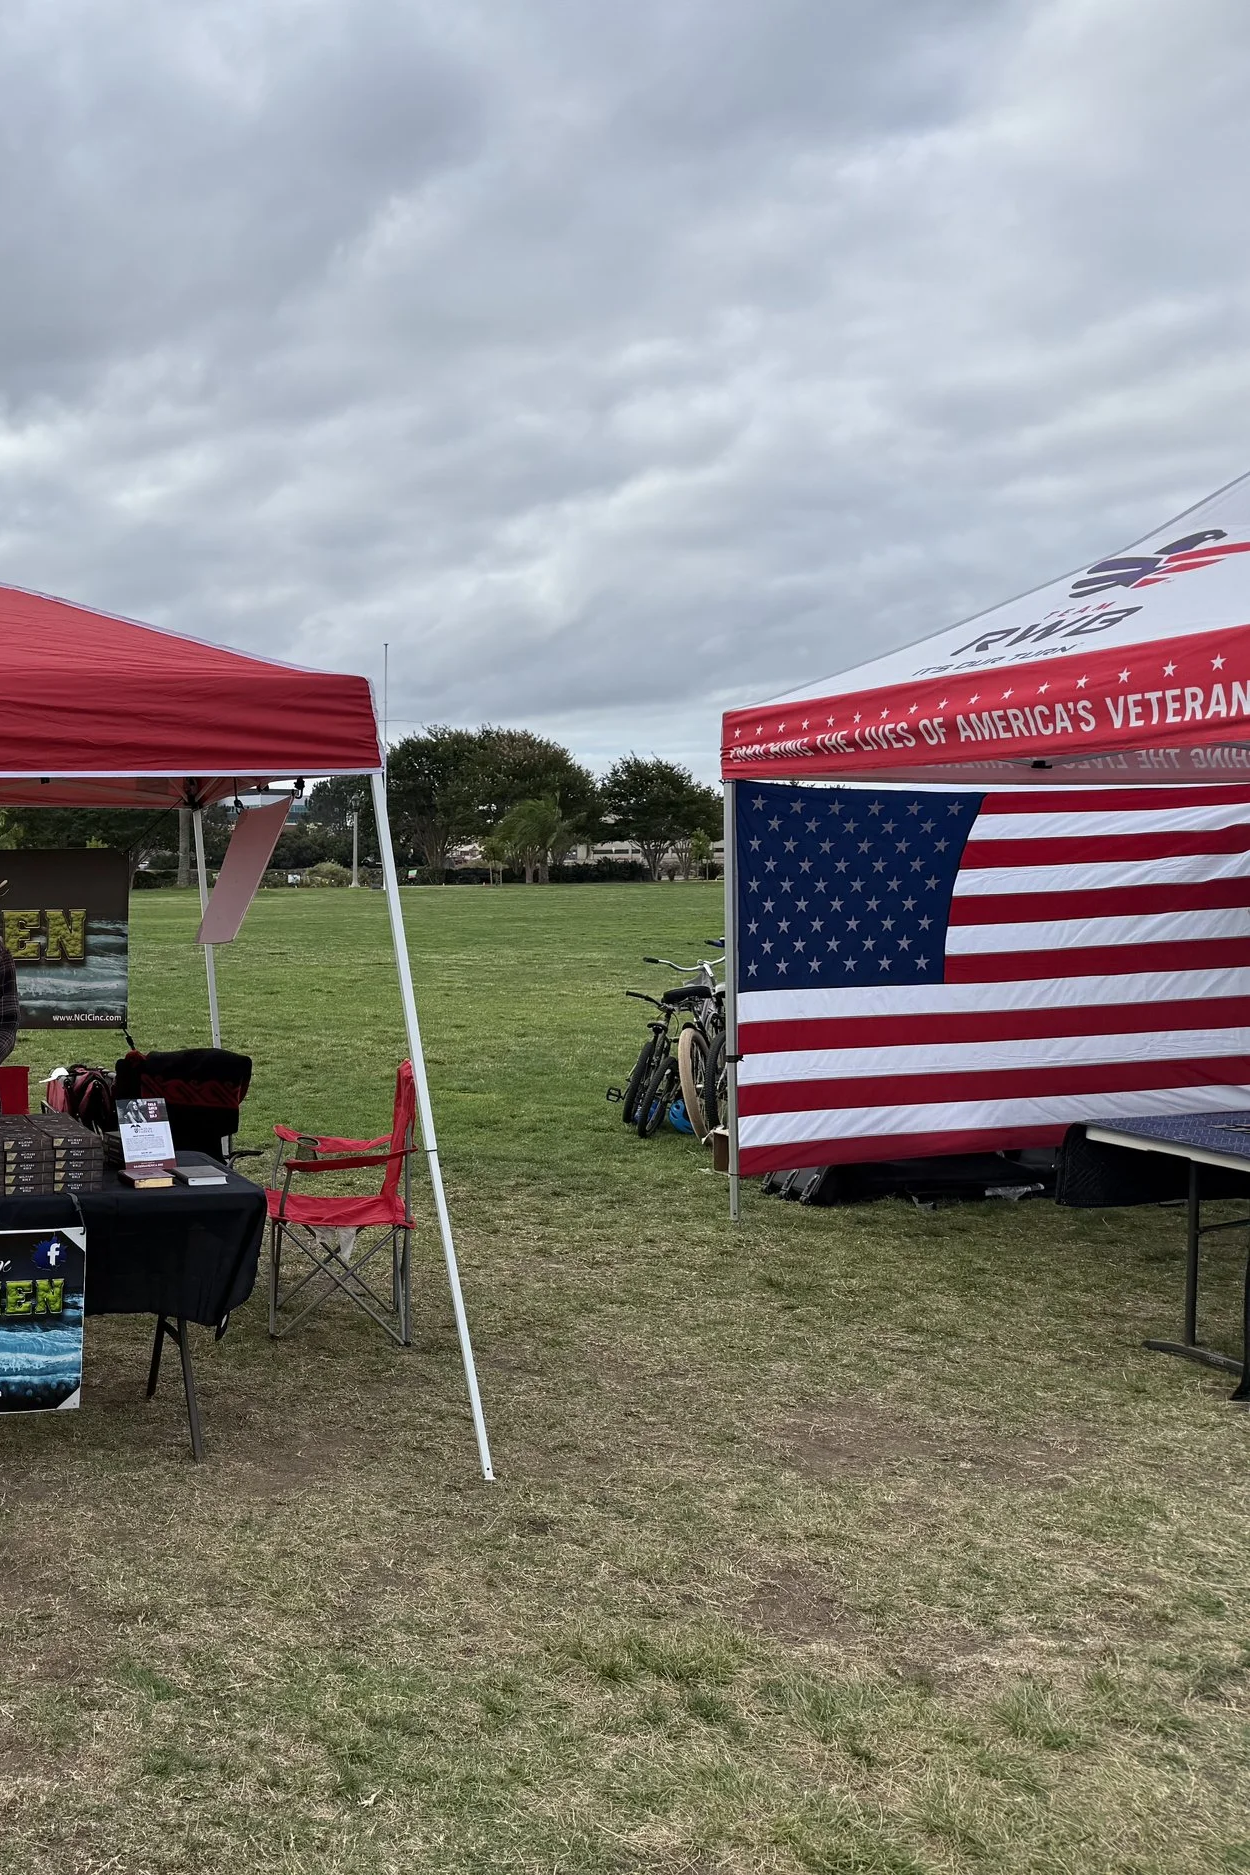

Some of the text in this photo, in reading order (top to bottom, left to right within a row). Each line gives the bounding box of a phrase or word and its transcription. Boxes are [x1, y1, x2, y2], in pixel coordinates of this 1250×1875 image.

[1044, 601, 1117, 620] TEAM
[950, 606, 1144, 656] RWB
[953, 656, 1006, 670] OUR
[1008, 642, 1078, 661] TURN
[815, 730, 856, 754] THE
[854, 724, 916, 752] LIVES
[918, 716, 948, 746] OF
[958, 700, 1096, 743] AMERICA'S
[1105, 680, 1250, 730] VETERAN
[52, 1014, 122, 1022] www.NCICinc.com
